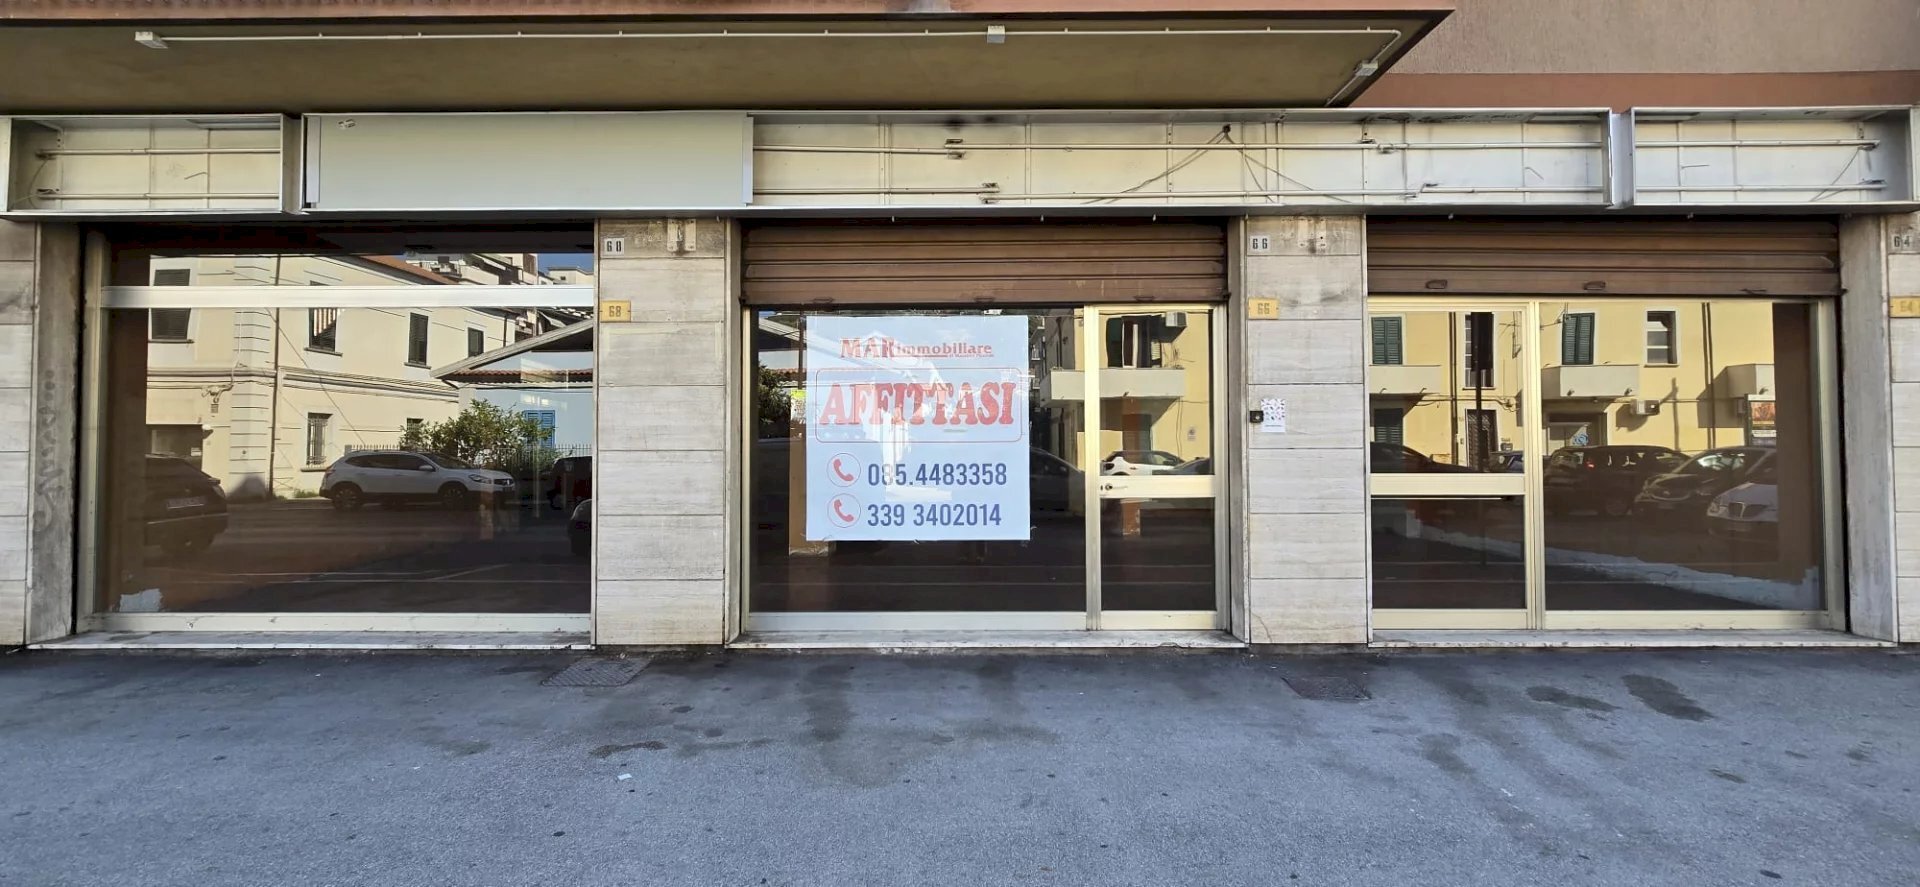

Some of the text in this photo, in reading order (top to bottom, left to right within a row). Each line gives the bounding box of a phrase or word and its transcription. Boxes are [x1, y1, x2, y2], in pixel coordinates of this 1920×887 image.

[606, 240, 622, 252] 68
[1252, 237, 1268, 250] 66
[608, 305, 622, 317] 68
[1257, 302, 1270, 315] 66
[819, 381, 1017, 426] AFFITTASI
[868, 463, 1007, 487] 085.4483358
[867, 503, 1002, 527] 339 3402014
